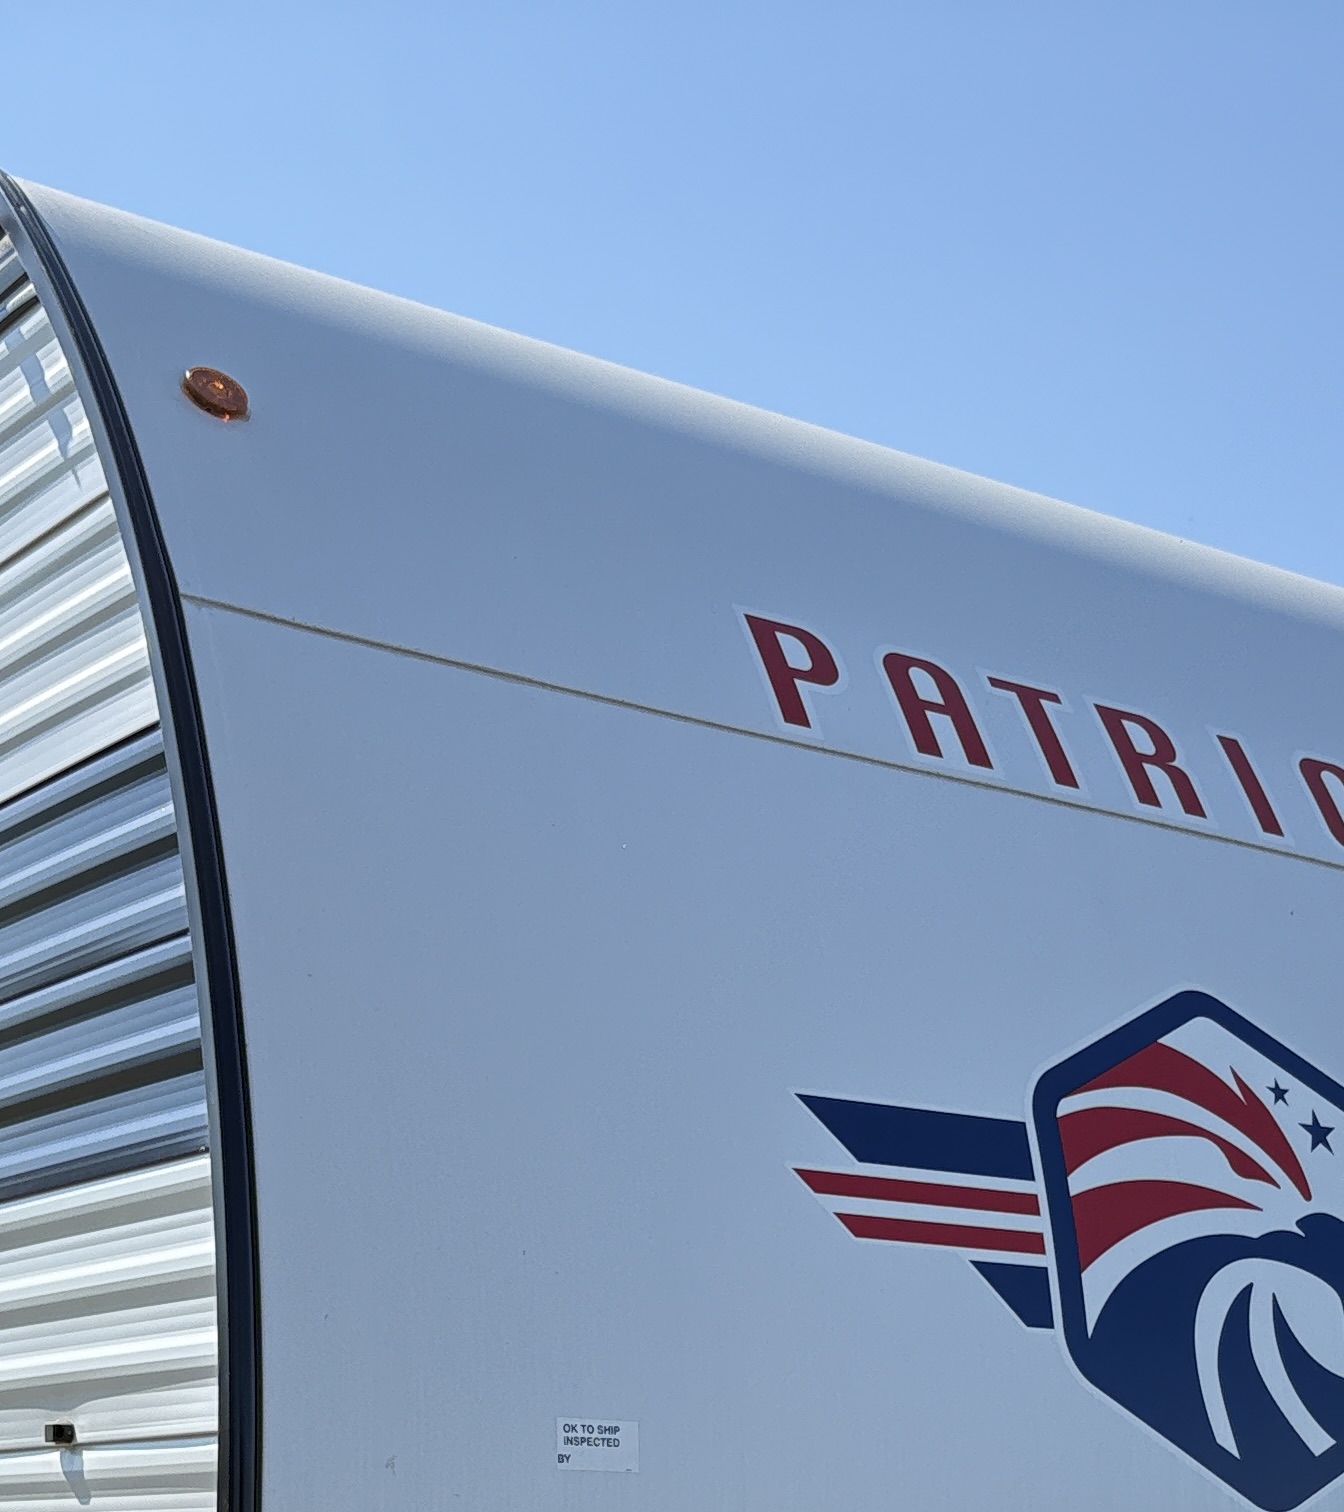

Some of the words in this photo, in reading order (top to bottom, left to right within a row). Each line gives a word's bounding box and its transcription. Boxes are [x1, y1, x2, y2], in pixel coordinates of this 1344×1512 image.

[562, 1423, 578, 1434] OK
[580, 1424, 595, 1434] TO
[597, 1425, 620, 1435] SHIP
[563, 1436, 620, 1448] INSPECTED
[557, 1453, 571, 1464] BY
